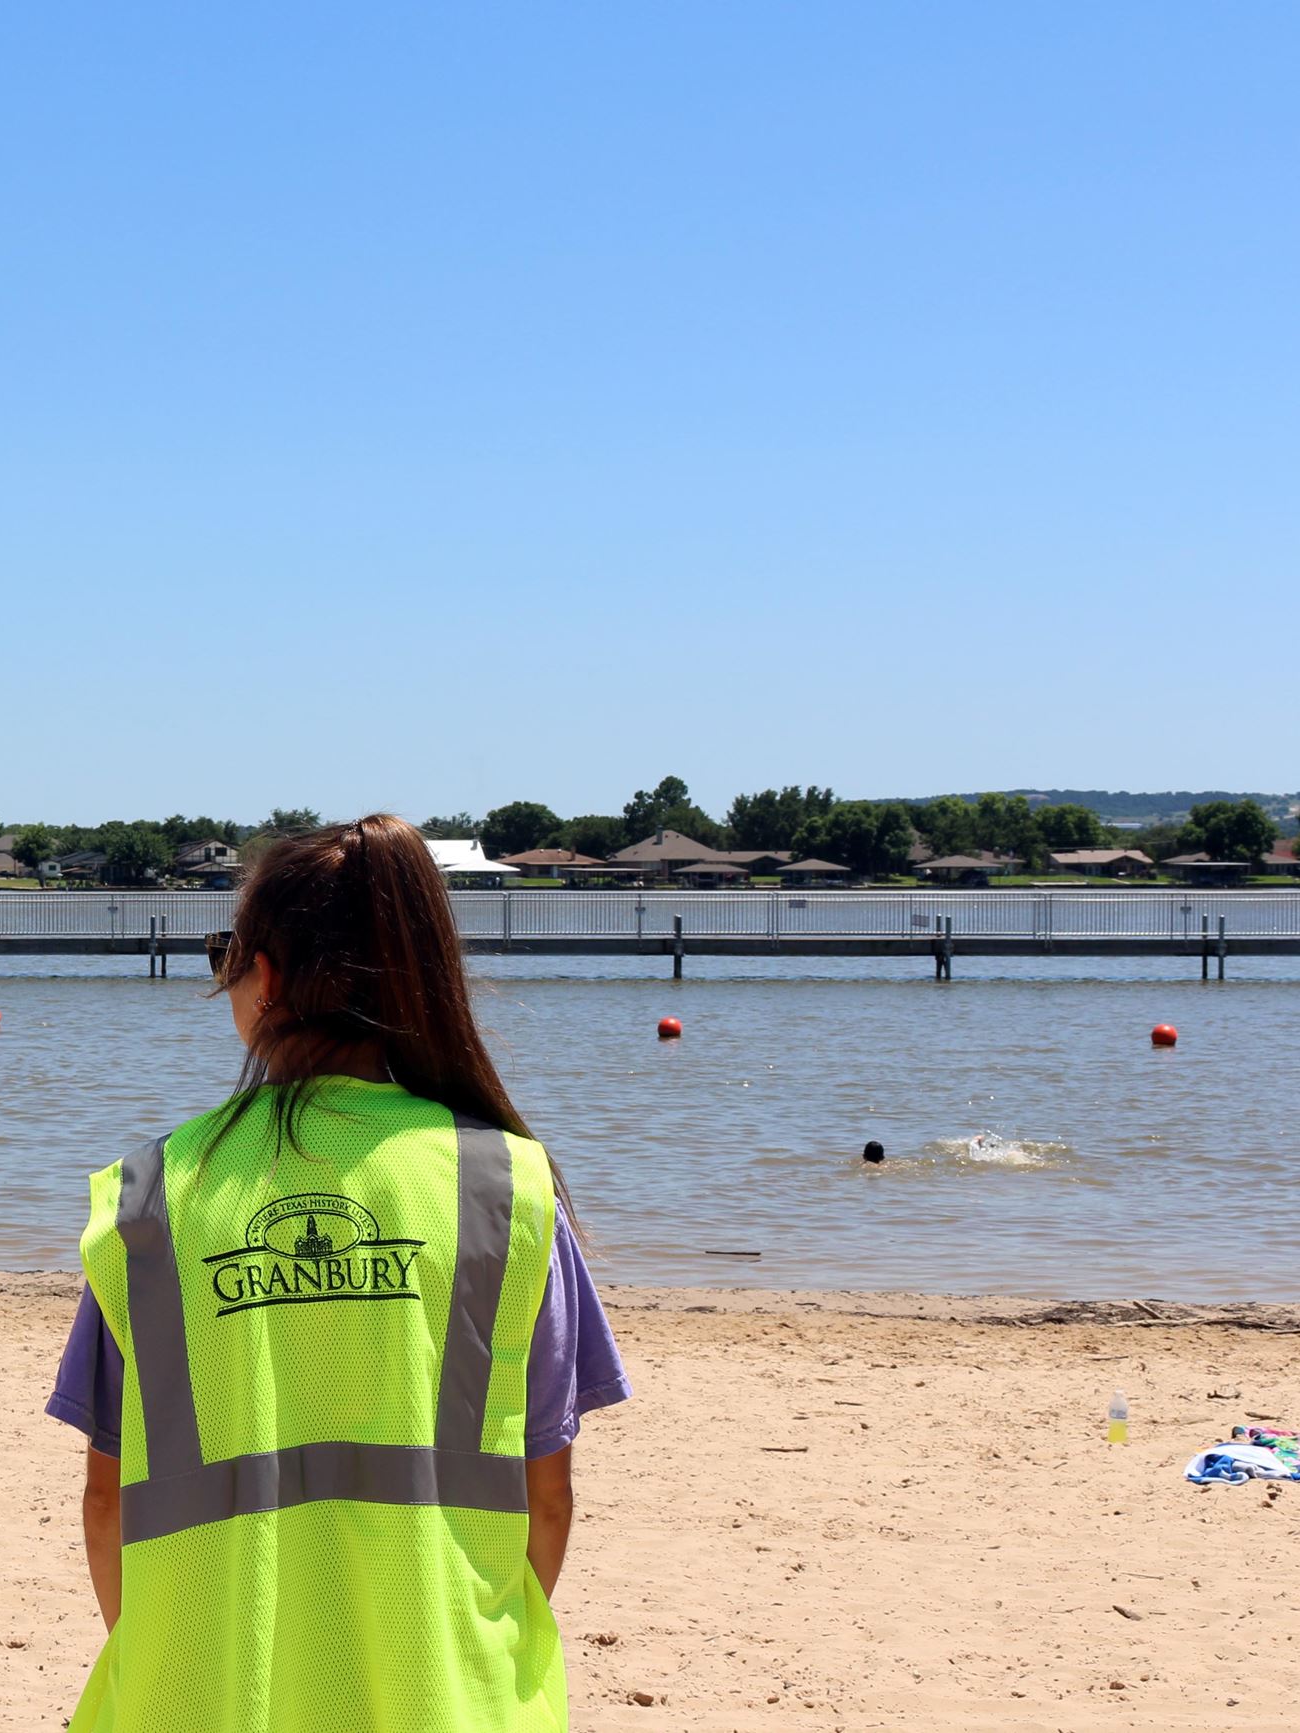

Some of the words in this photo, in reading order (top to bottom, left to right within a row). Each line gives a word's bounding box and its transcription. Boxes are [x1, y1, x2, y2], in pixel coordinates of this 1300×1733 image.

[251, 1207, 280, 1234] WHERE
[280, 1200, 307, 1212] TEXAS
[309, 1199, 351, 1211] HISTORY
[352, 1207, 374, 1228] LIVES
[213, 1251, 419, 1302] GRANBURY
